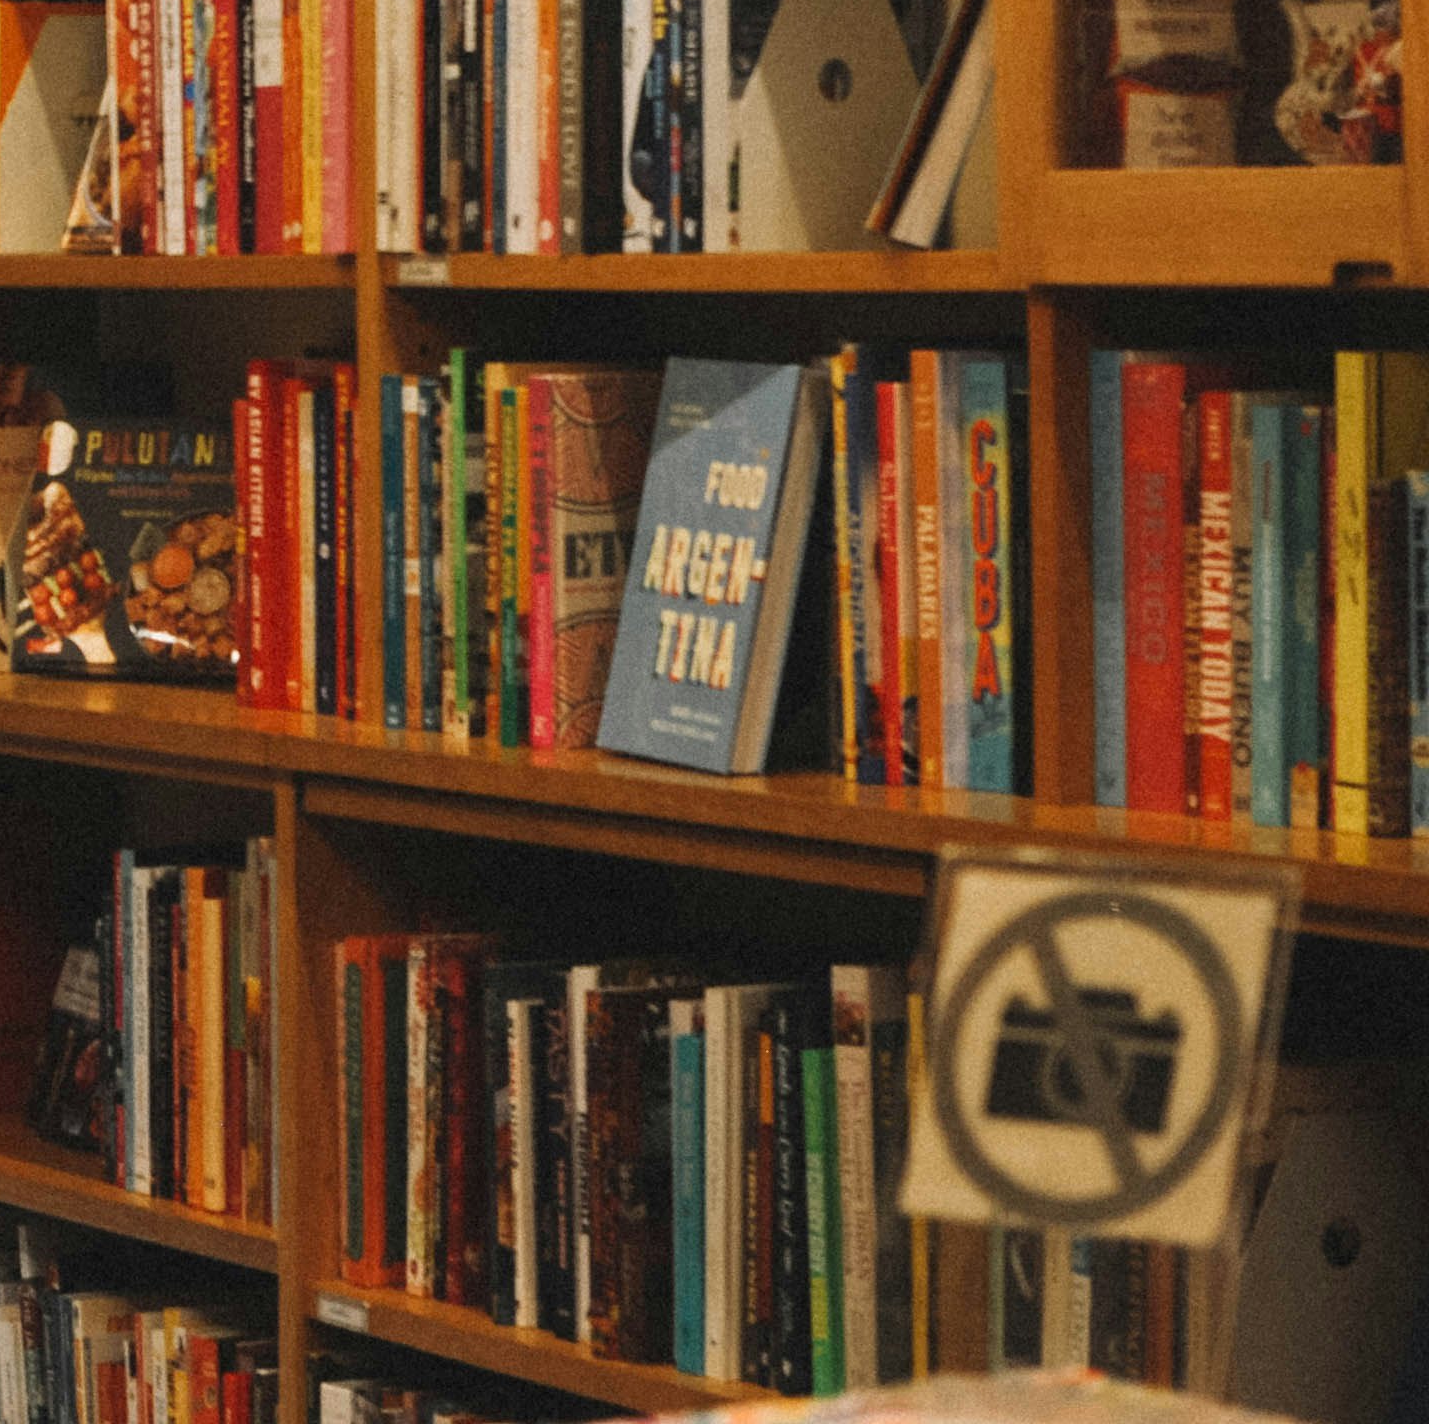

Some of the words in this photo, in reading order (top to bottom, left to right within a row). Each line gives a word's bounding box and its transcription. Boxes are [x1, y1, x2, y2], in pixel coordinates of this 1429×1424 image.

[560, 17, 576, 96] FOOD
[561, 124, 577, 190] LOVE
[84, 431, 214, 466] PULUTAN
[248, 405, 262, 459] ASIAN
[249, 464, 263, 537] KITCHEN
[705, 460, 769, 510] FOOD
[643, 523, 766, 606] ARGEN-
[915, 502, 939, 640] PALADARES
[970, 418, 1002, 704] CUBA
[1200, 489, 1231, 632] MEXICAN
[1231, 545, 1252, 632] MUY
[654, 608, 737, 691] TINA
[1199, 640, 1231, 742] TODAY
[1232, 638, 1252, 769] BUENO
